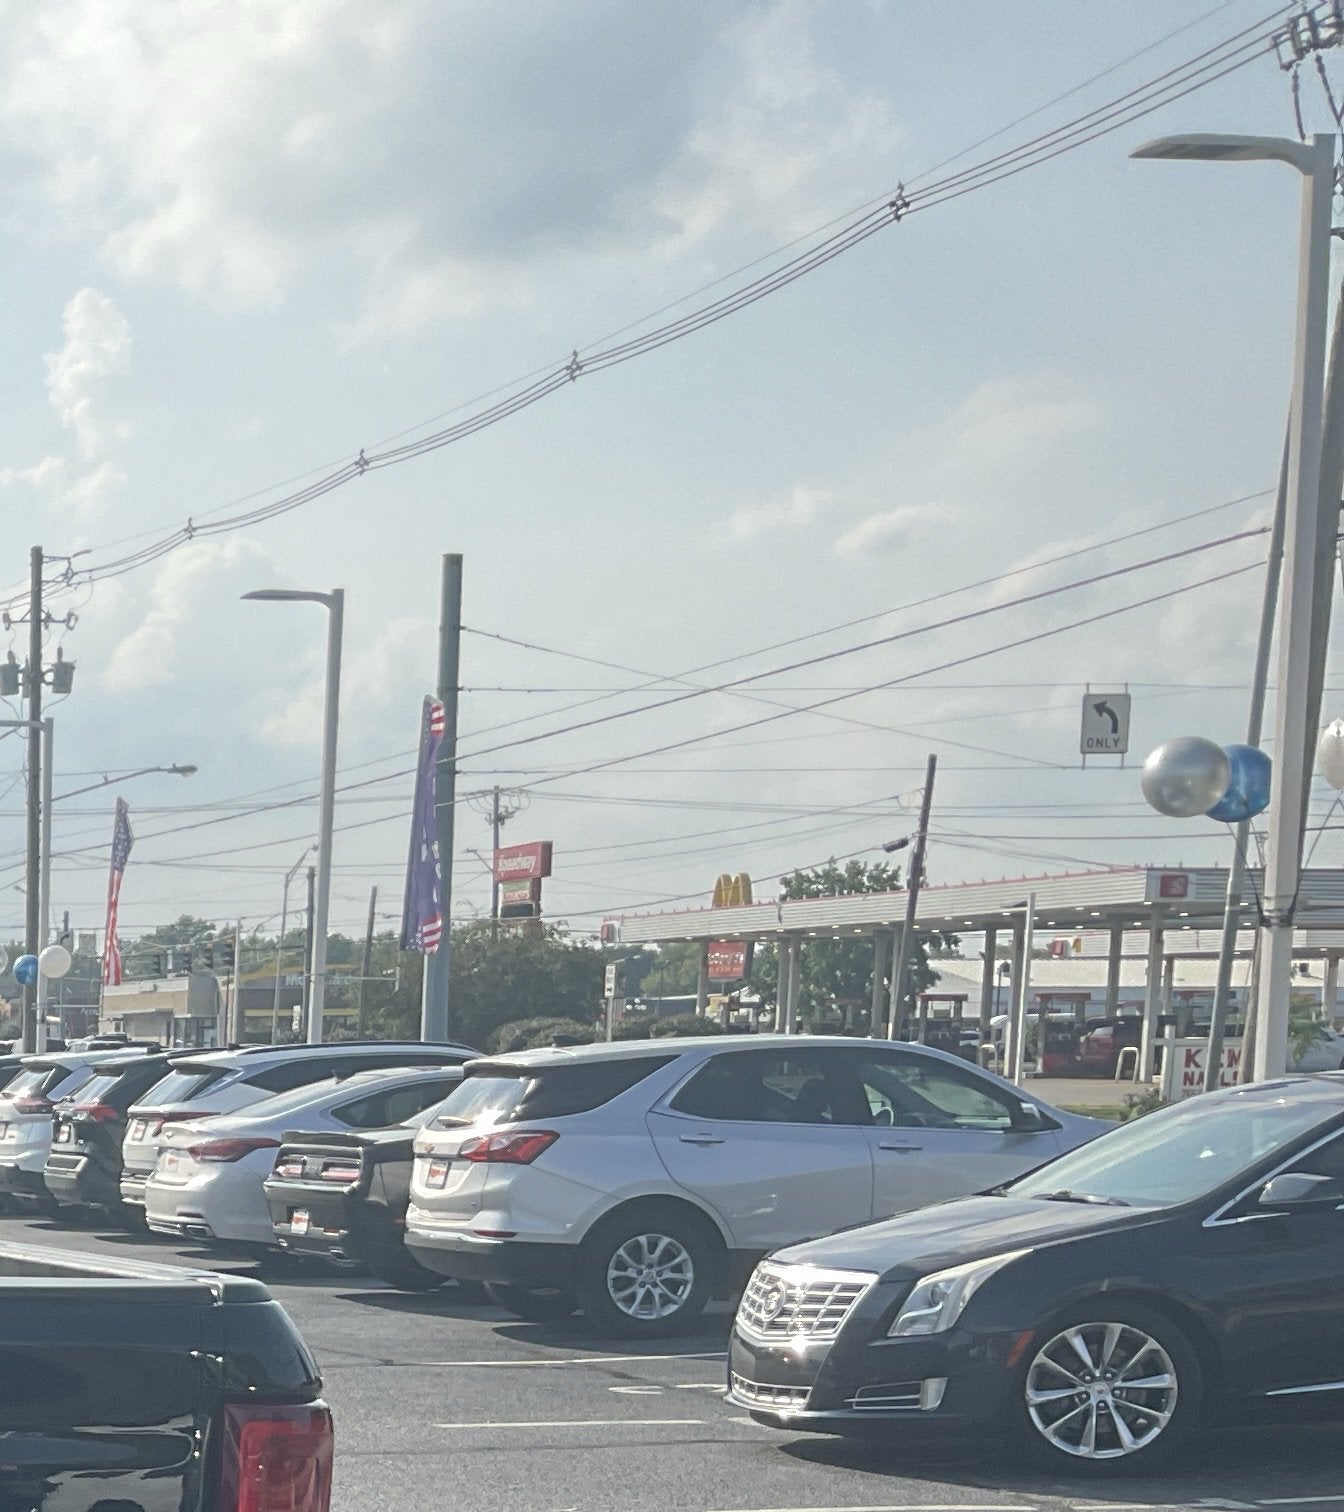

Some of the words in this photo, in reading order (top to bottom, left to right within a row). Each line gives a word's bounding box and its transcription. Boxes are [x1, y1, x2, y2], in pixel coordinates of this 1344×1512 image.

[1086, 737, 1121, 749] ONLY
[1184, 1048, 1242, 1068] KM
[1183, 1071, 1239, 1086] NAL
